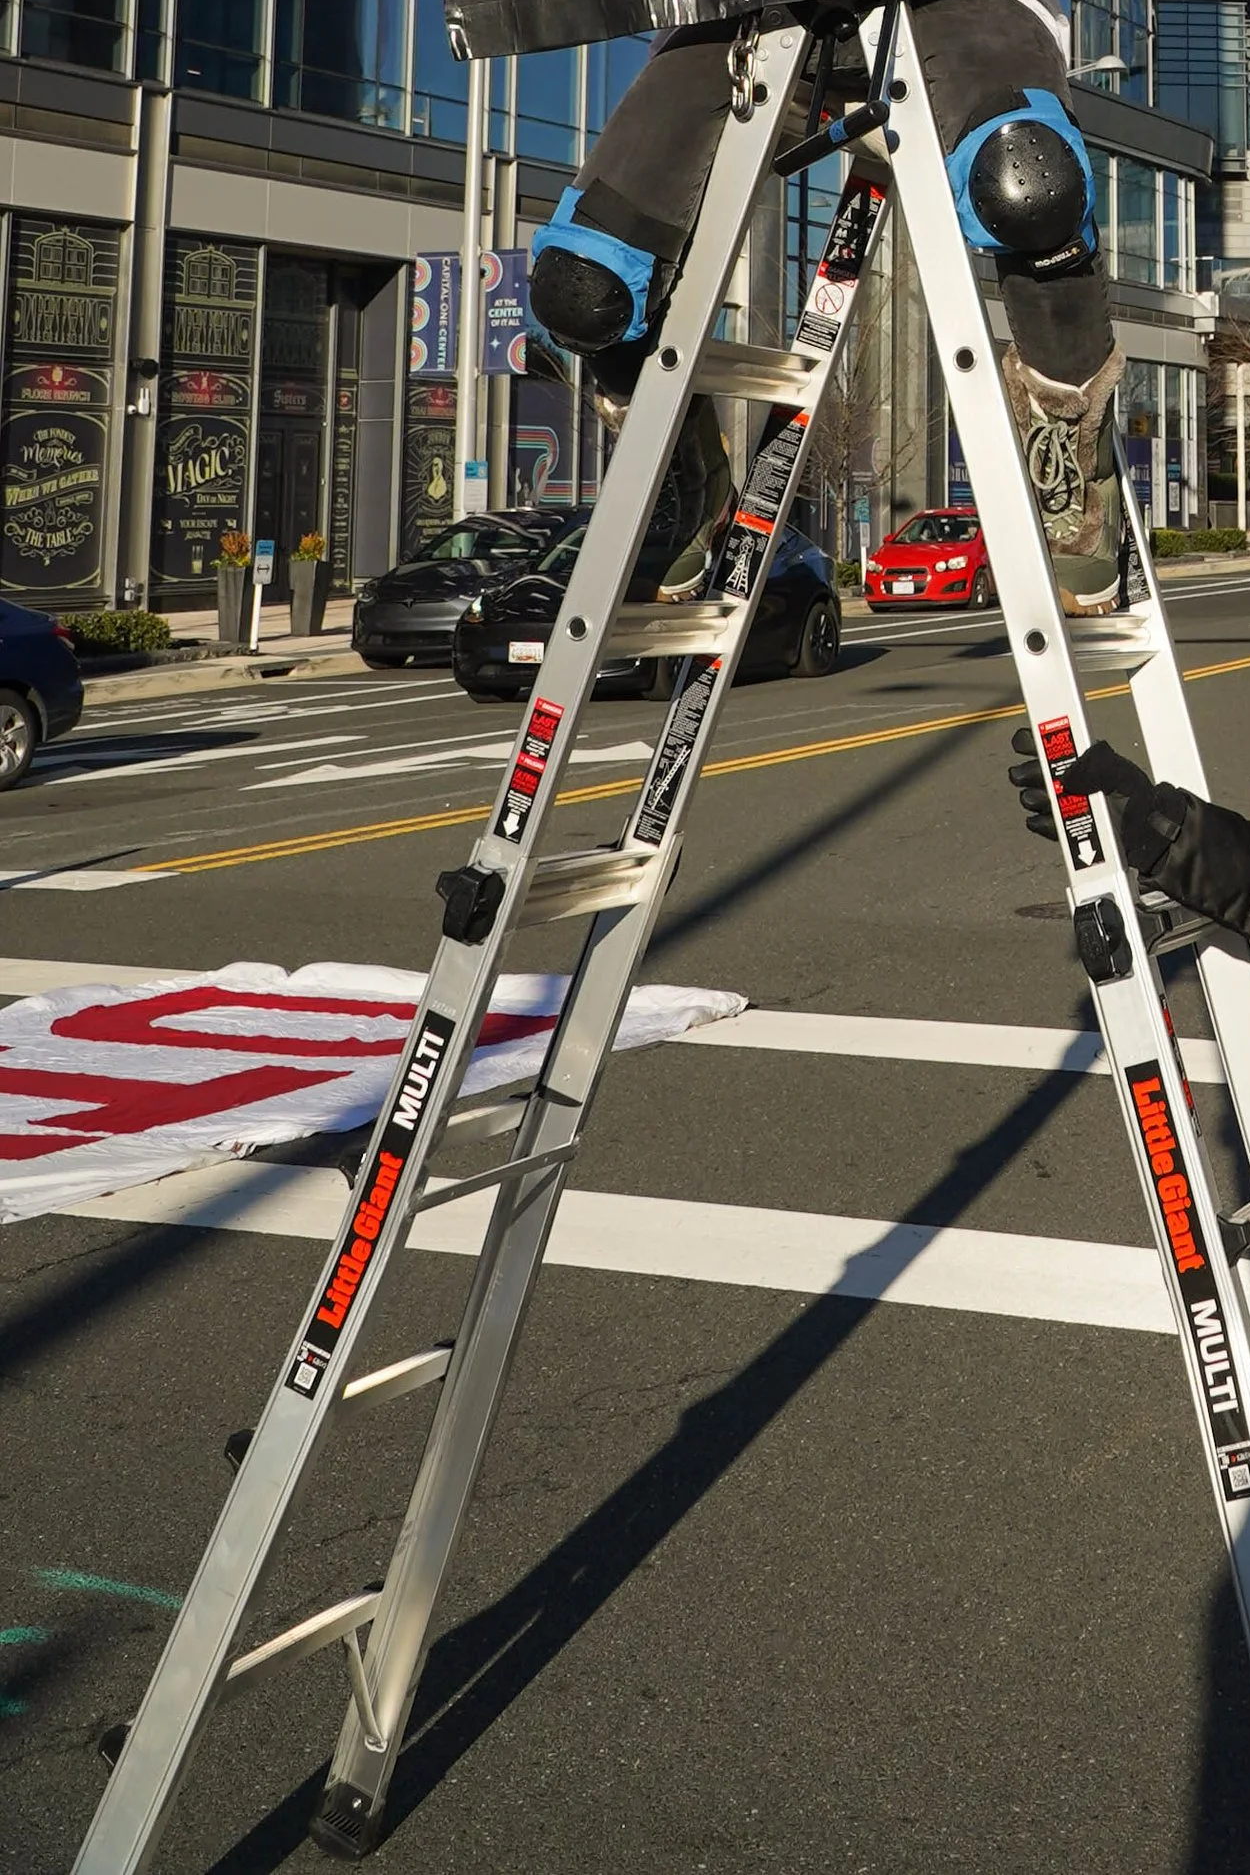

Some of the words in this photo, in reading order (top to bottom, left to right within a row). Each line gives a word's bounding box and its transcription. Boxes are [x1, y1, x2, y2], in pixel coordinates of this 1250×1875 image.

[488, 307, 523, 318] CENTER
[494, 298, 504, 307] AT
[504, 298, 518, 306] THE
[439, 303, 449, 326] ONE
[491, 319, 500, 327] OF
[508, 318, 520, 326] ALL
[272, 389, 308, 408] Sisters
[22, 443, 84, 467] Memories
[25, 526, 44, 547] THE
[45, 527, 74, 548] TABLE
[1044, 731, 1070, 746] LAST
[392, 1029, 446, 1131] MULTI
[1190, 1297, 1239, 1414] MULTI
